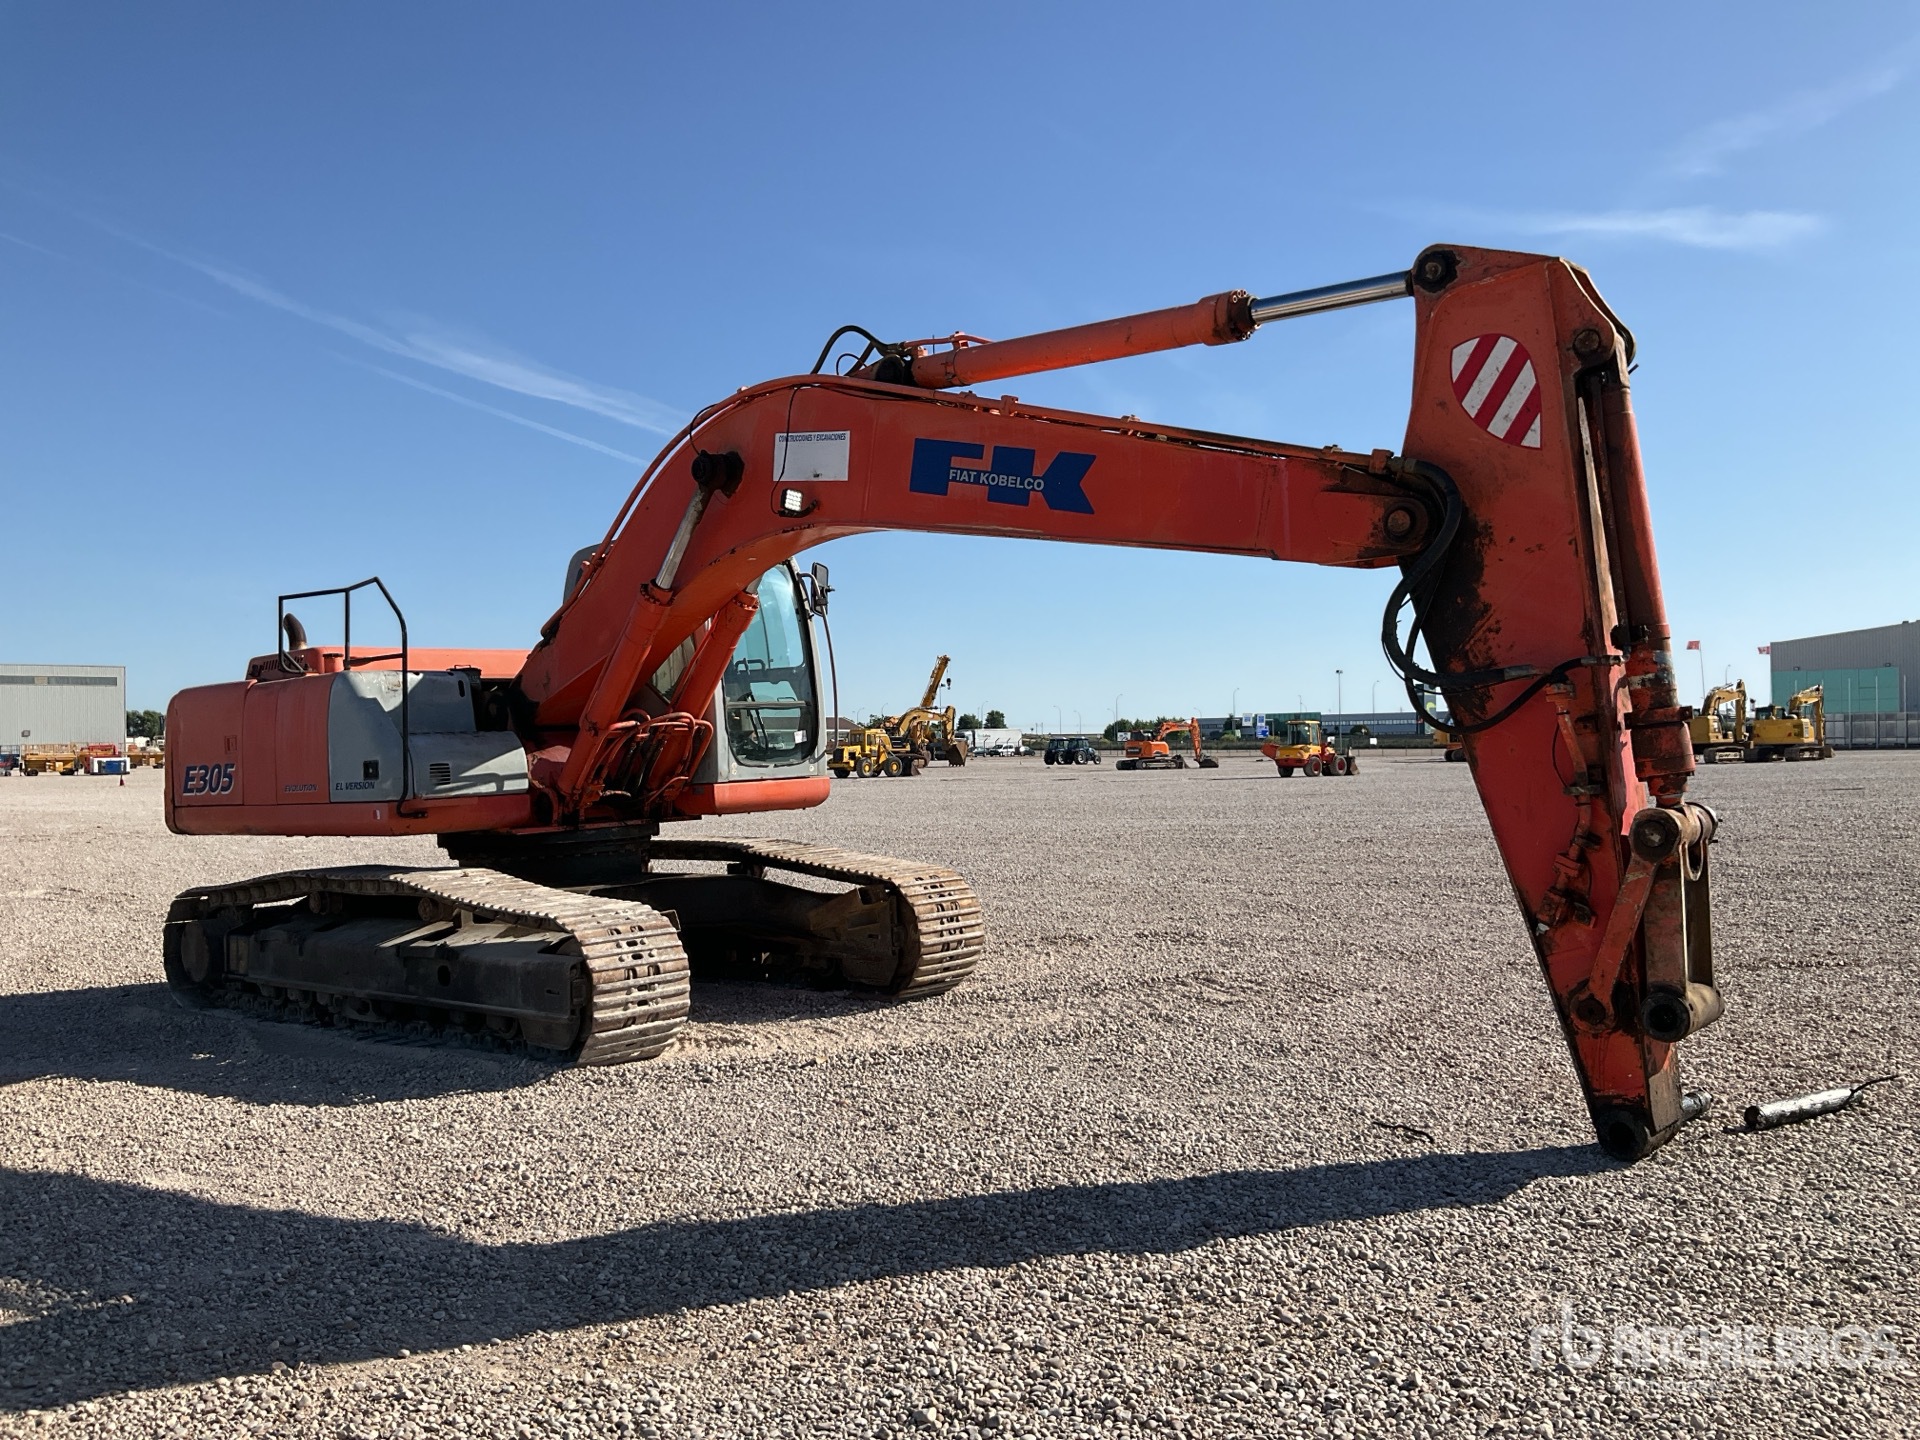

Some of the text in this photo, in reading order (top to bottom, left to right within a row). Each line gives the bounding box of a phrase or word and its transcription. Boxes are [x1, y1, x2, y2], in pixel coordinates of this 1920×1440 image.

[778, 434, 812, 442] CONTRUCCIONES
[949, 469, 1045, 491] FIAT KOBELCO
[183, 763, 236, 796] E305
[284, 784, 319, 793] EVOLUTION
[335, 781, 375, 791] EL VERSION
